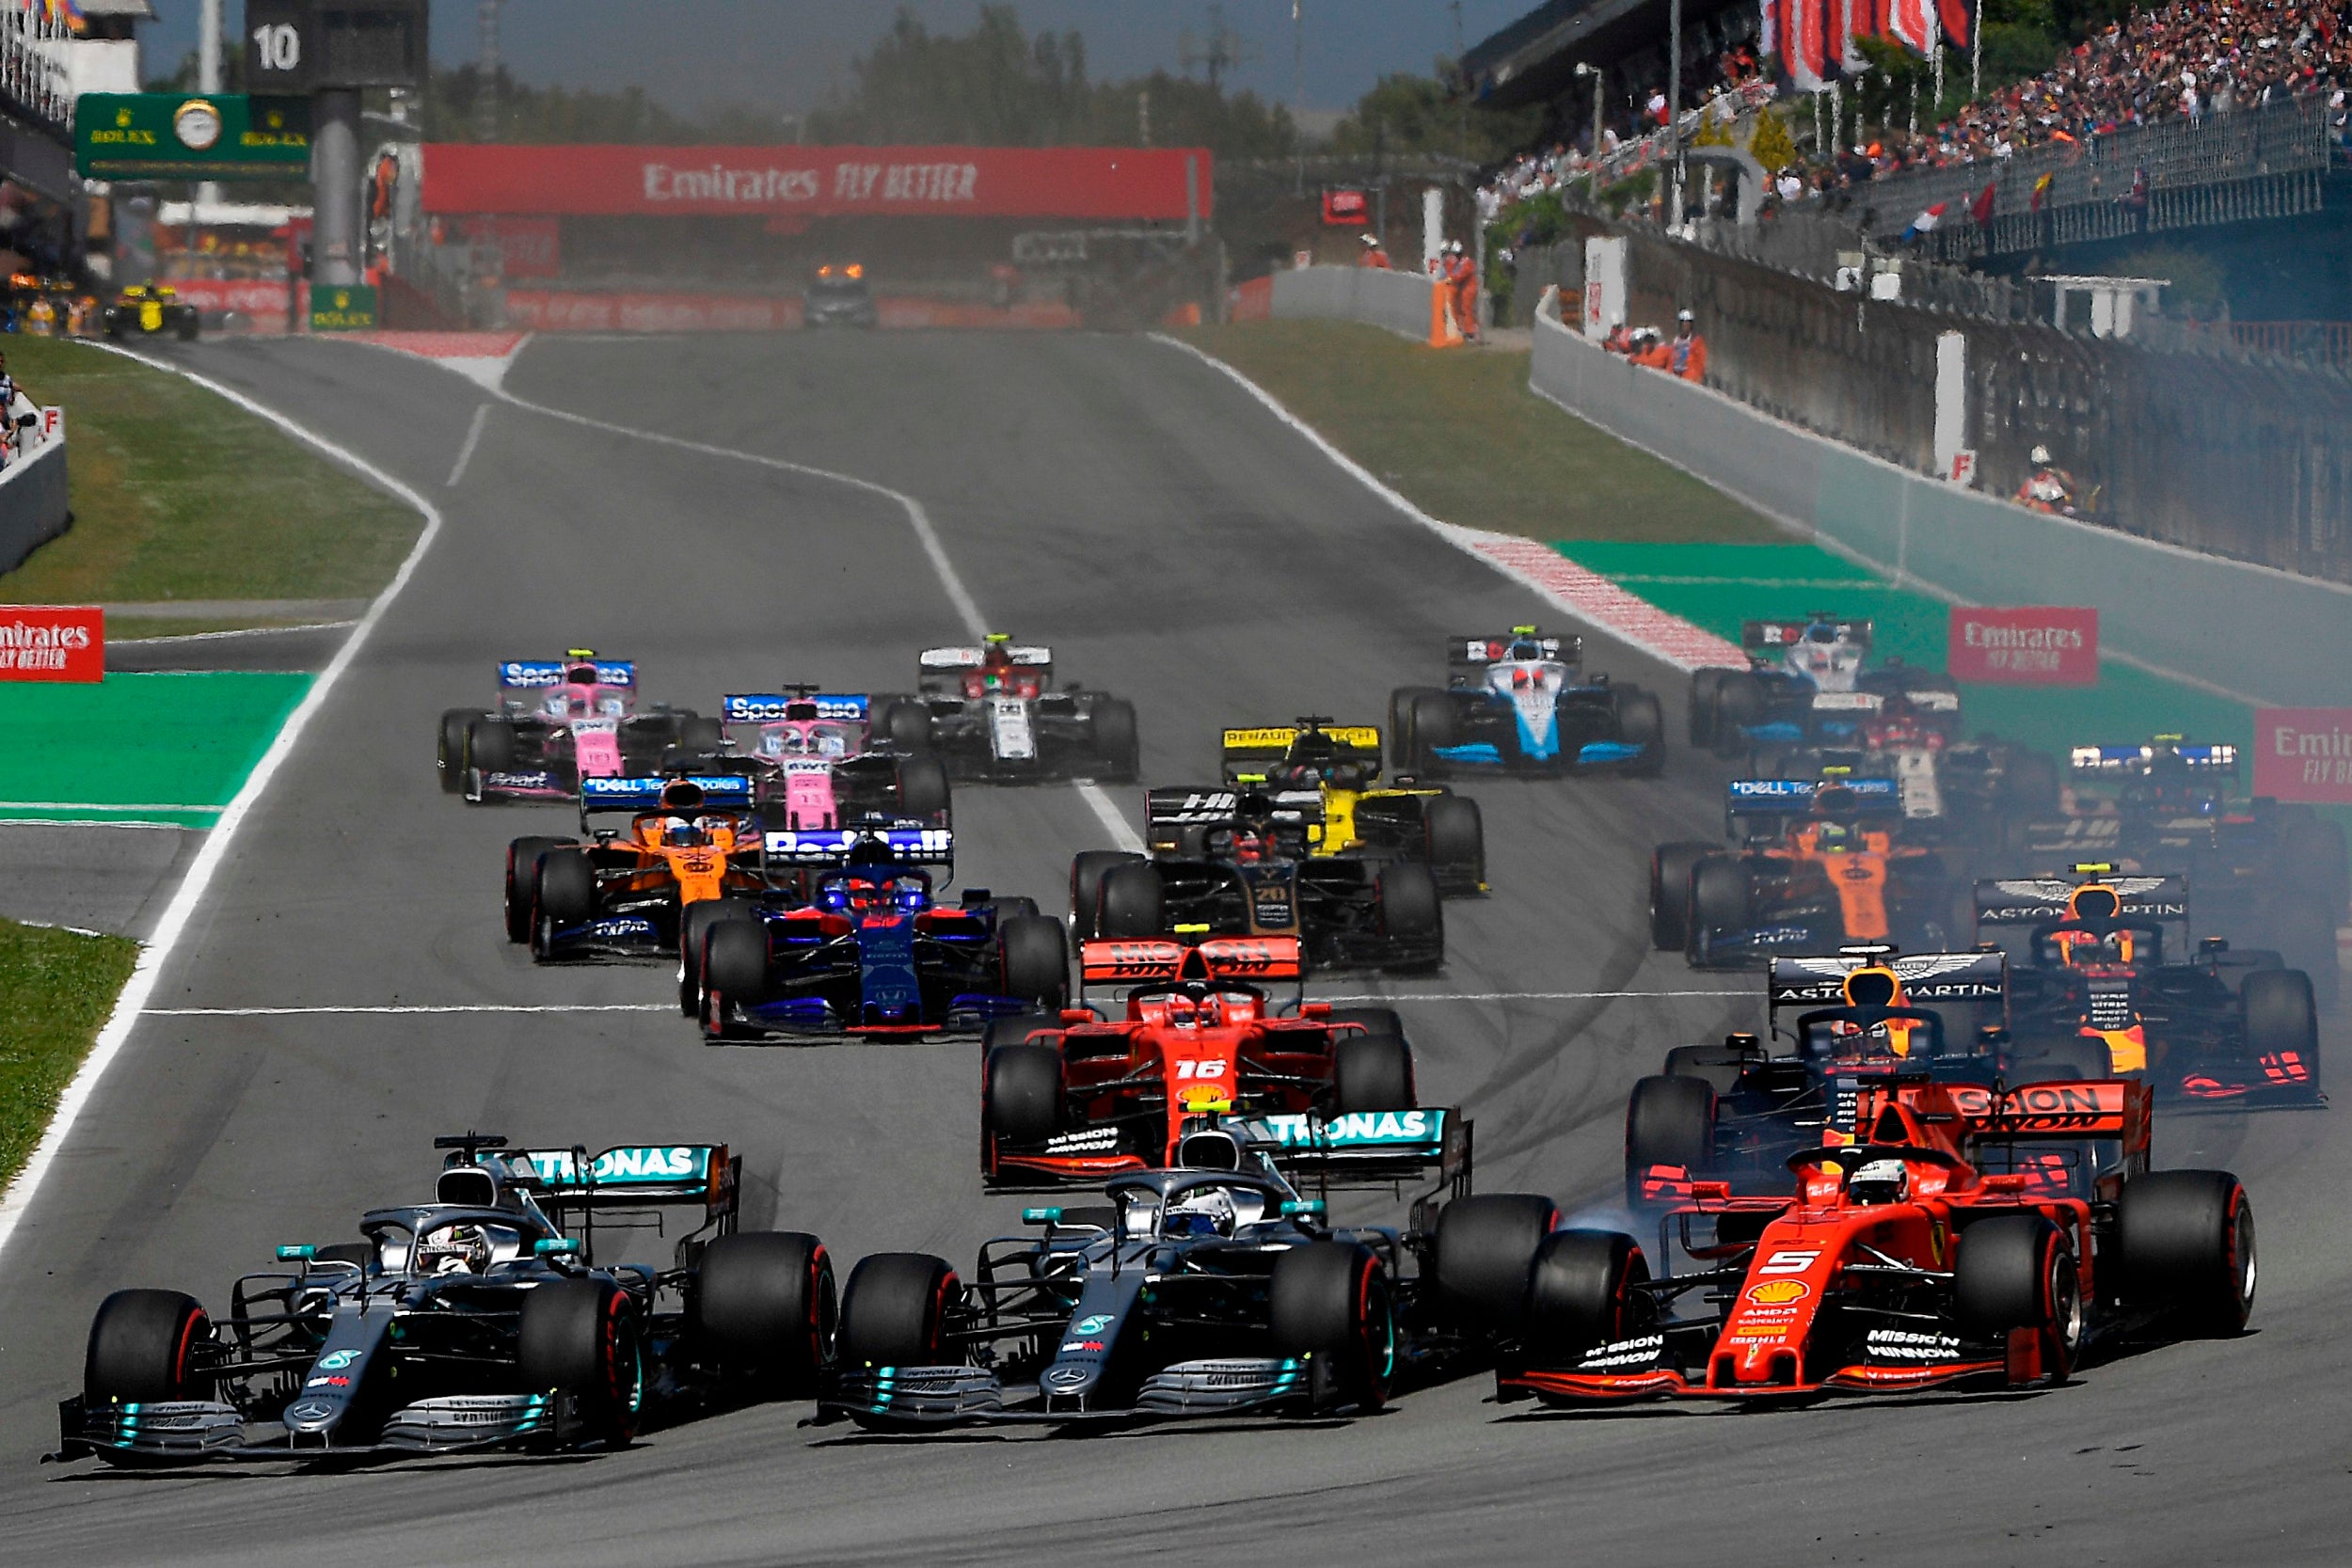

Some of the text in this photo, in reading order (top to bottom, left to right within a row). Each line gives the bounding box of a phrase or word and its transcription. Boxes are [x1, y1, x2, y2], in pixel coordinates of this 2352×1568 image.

[253, 23, 301, 69] 10
[91, 131, 155, 145] ROLEX
[644, 162, 977, 201] Emirates FLY BETTER
[45, 410, 57, 433] F
[1952, 455, 1970, 480] F
[0, 620, 90, 649] mirates
[1965, 623, 2083, 649] Emirates
[2275, 727, 2352, 756] Emir
[595, 779, 643, 792] DELL
[1741, 781, 1788, 795] DELL
[1110, 941, 1271, 963] MISON
[1175, 1059, 1227, 1080] 16
[1758, 1251, 1822, 1275] 5
[1729, 1336, 1788, 1344] MAHLE
[1867, 1330, 1961, 1346] MISSION
